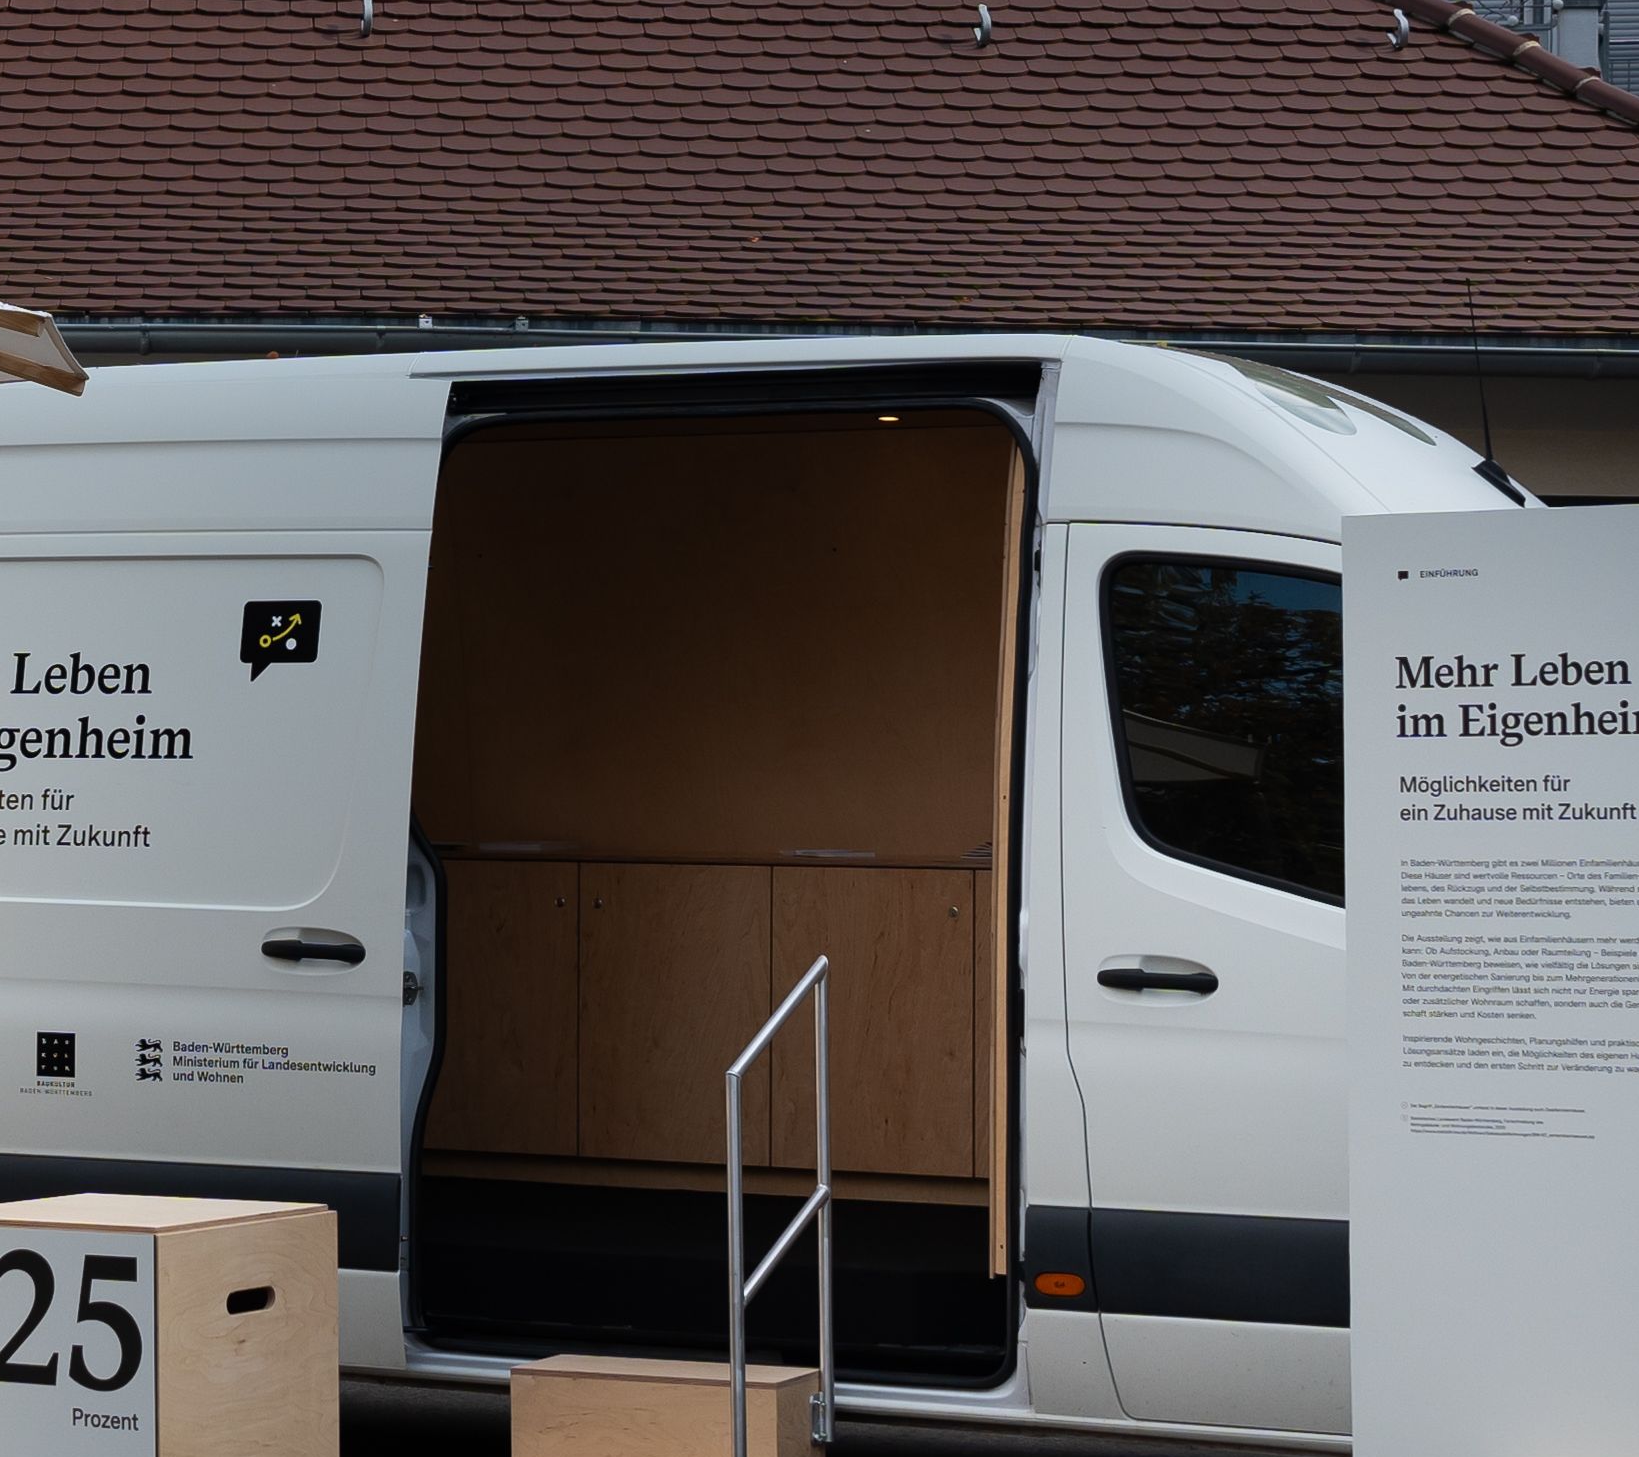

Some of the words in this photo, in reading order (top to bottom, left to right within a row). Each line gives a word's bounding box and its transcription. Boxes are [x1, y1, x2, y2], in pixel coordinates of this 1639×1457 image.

[1419, 568, 1479, 579] EINFÜHRUNG
[10, 651, 152, 694] Leben
[1394, 654, 1499, 689] Mehr
[1510, 652, 1632, 687] Leben
[1395, 703, 1447, 738] im
[1400, 775, 1537, 797] Möglichkeiten
[1542, 774, 1571, 792] für
[41, 788, 75, 811] für
[1399, 803, 1428, 821] ein
[1433, 803, 1517, 821] Zuhause
[1522, 802, 1554, 820] mit
[1557, 802, 1637, 820] Zukunft
[13, 823, 50, 846] mit
[56, 824, 151, 847] Zukunft
[172, 1040, 289, 1059] Baden-Württemberg
[172, 1055, 240, 1069] Ministerium
[242, 1057, 259, 1069] für
[261, 1058, 376, 1077] Landesentwicklung
[172, 1070, 194, 1082] und
[196, 1070, 244, 1084] Wohnen
[72, 1407, 139, 1431] Prozent
